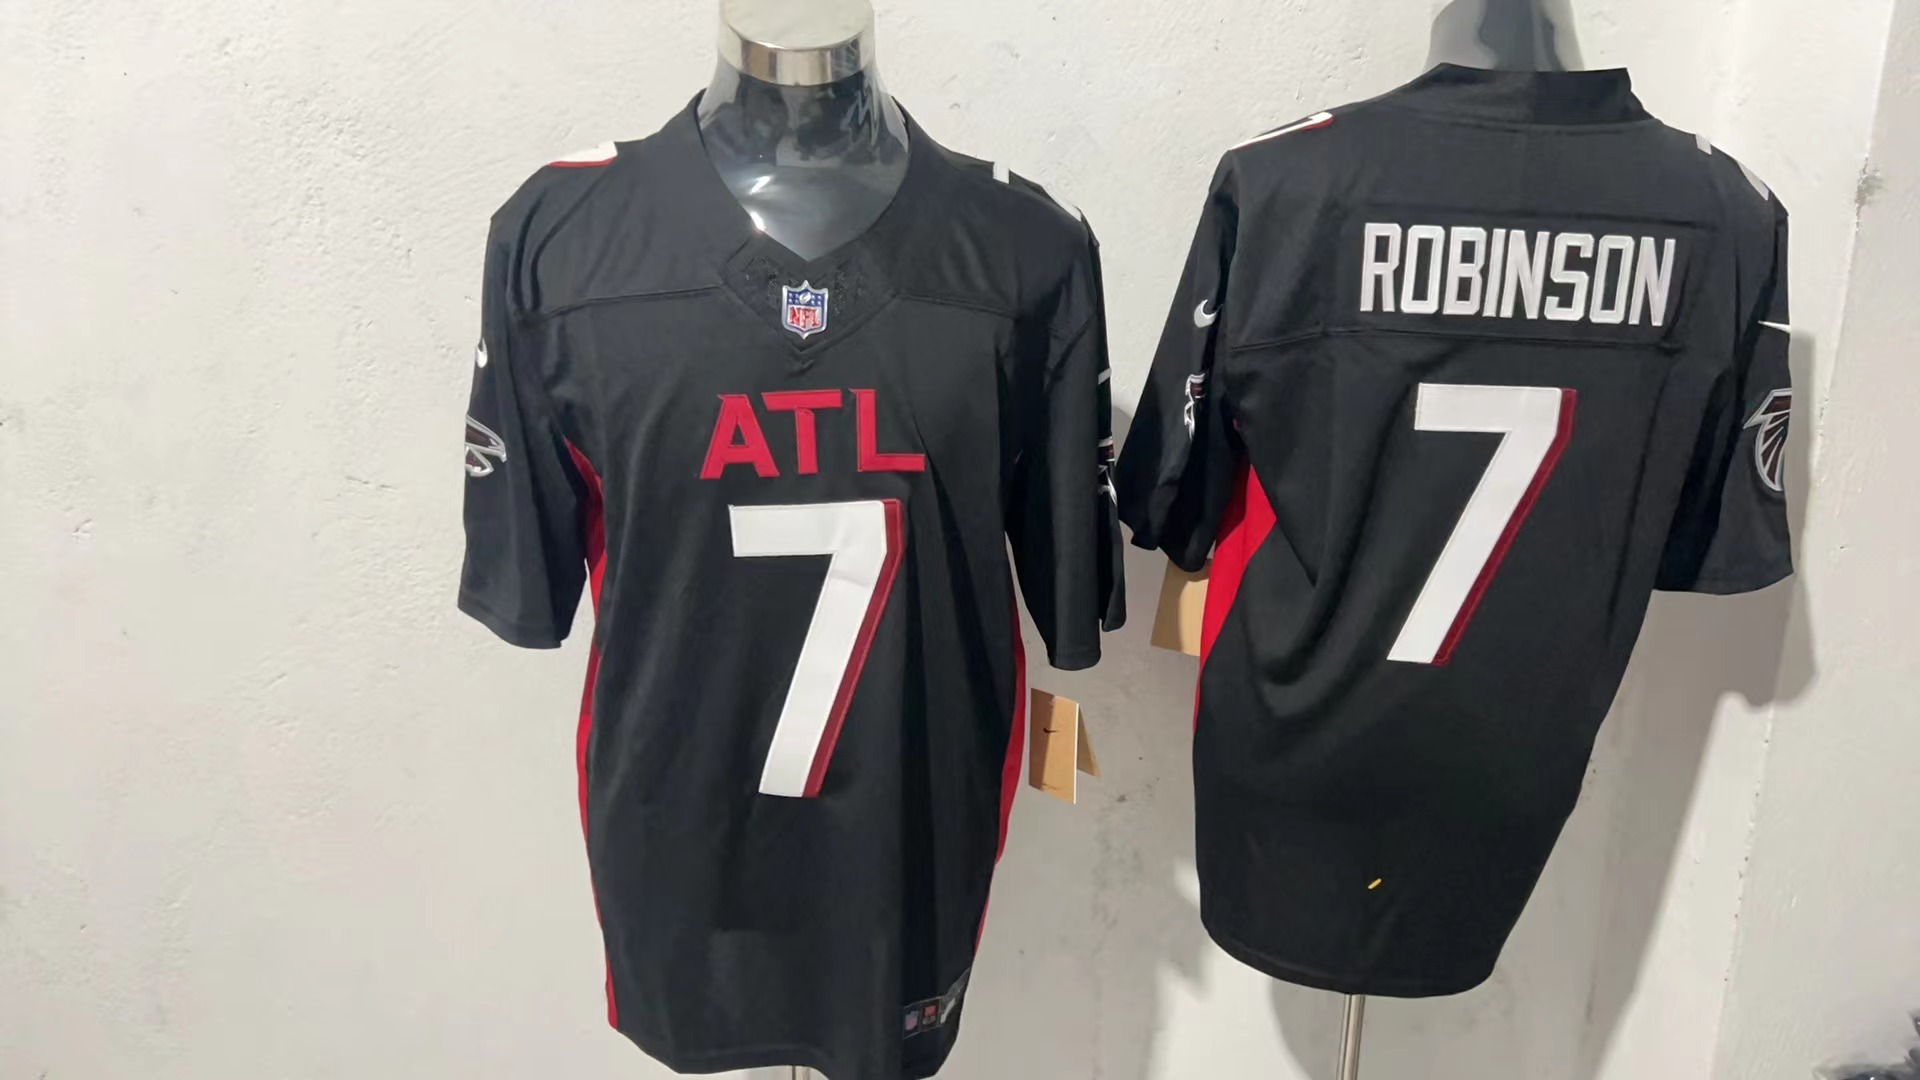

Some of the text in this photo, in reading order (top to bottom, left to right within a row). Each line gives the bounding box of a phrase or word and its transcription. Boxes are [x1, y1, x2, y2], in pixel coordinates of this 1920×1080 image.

[789, 306, 820, 329] NFL
[1360, 222, 1676, 327] ROBINSON
[700, 388, 926, 480] ATL
[1386, 382, 1577, 667] 7
[728, 498, 906, 797] 7
